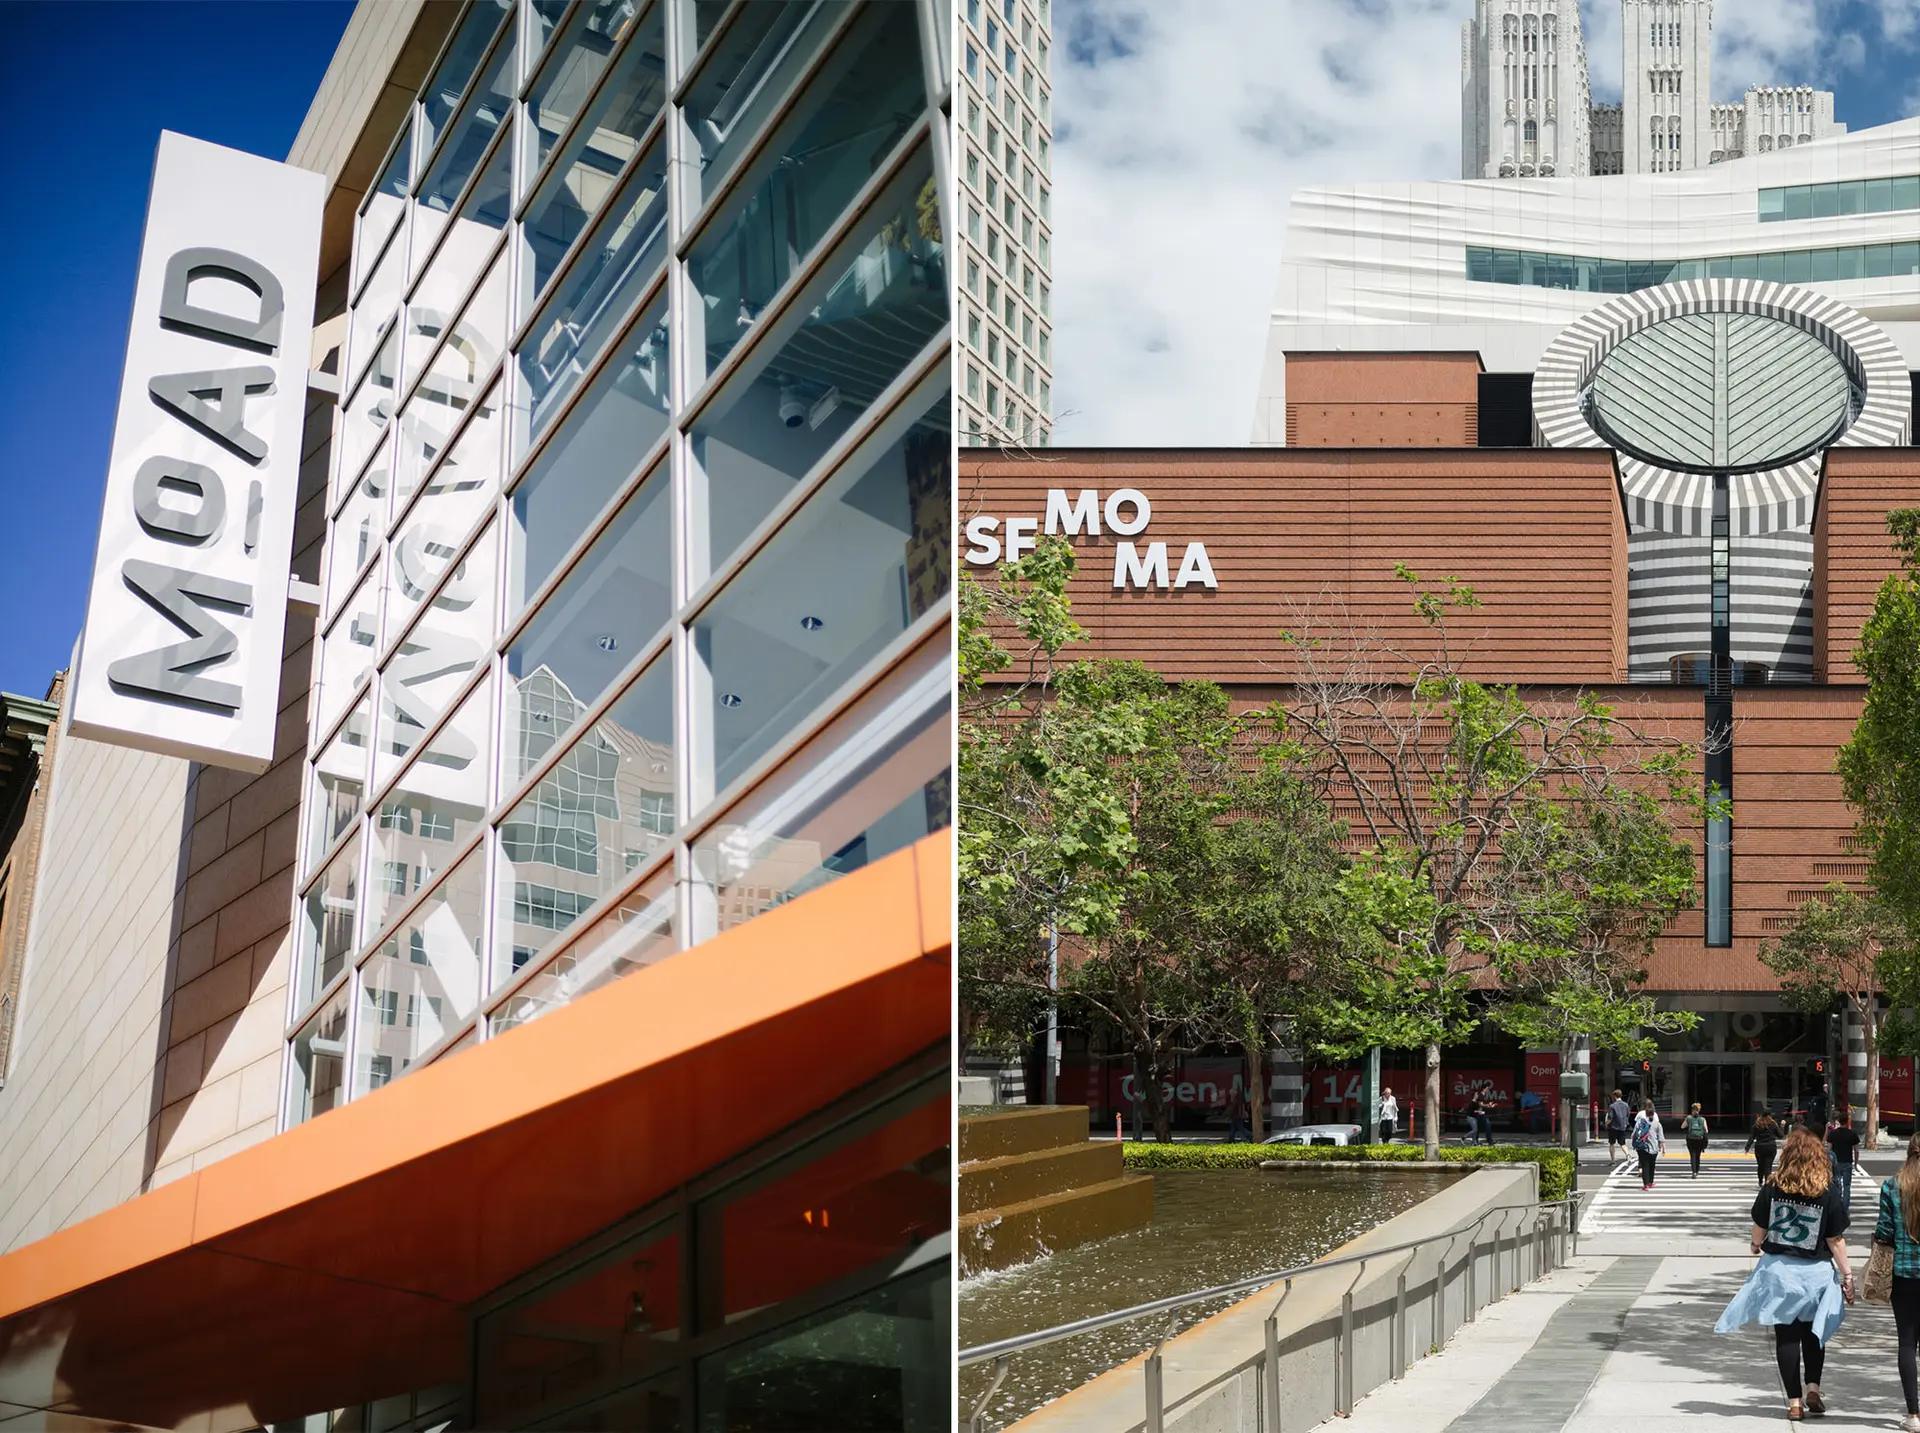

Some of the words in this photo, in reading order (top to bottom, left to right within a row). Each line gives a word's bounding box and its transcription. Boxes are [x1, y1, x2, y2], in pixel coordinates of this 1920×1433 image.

[1530, 1065, 1556, 1077] Open
[1879, 1068, 1894, 1079] ay
[1897, 1068, 1909, 1078] 14
[1323, 1074, 1363, 1105] 14
[1769, 1205, 1819, 1243] 25
